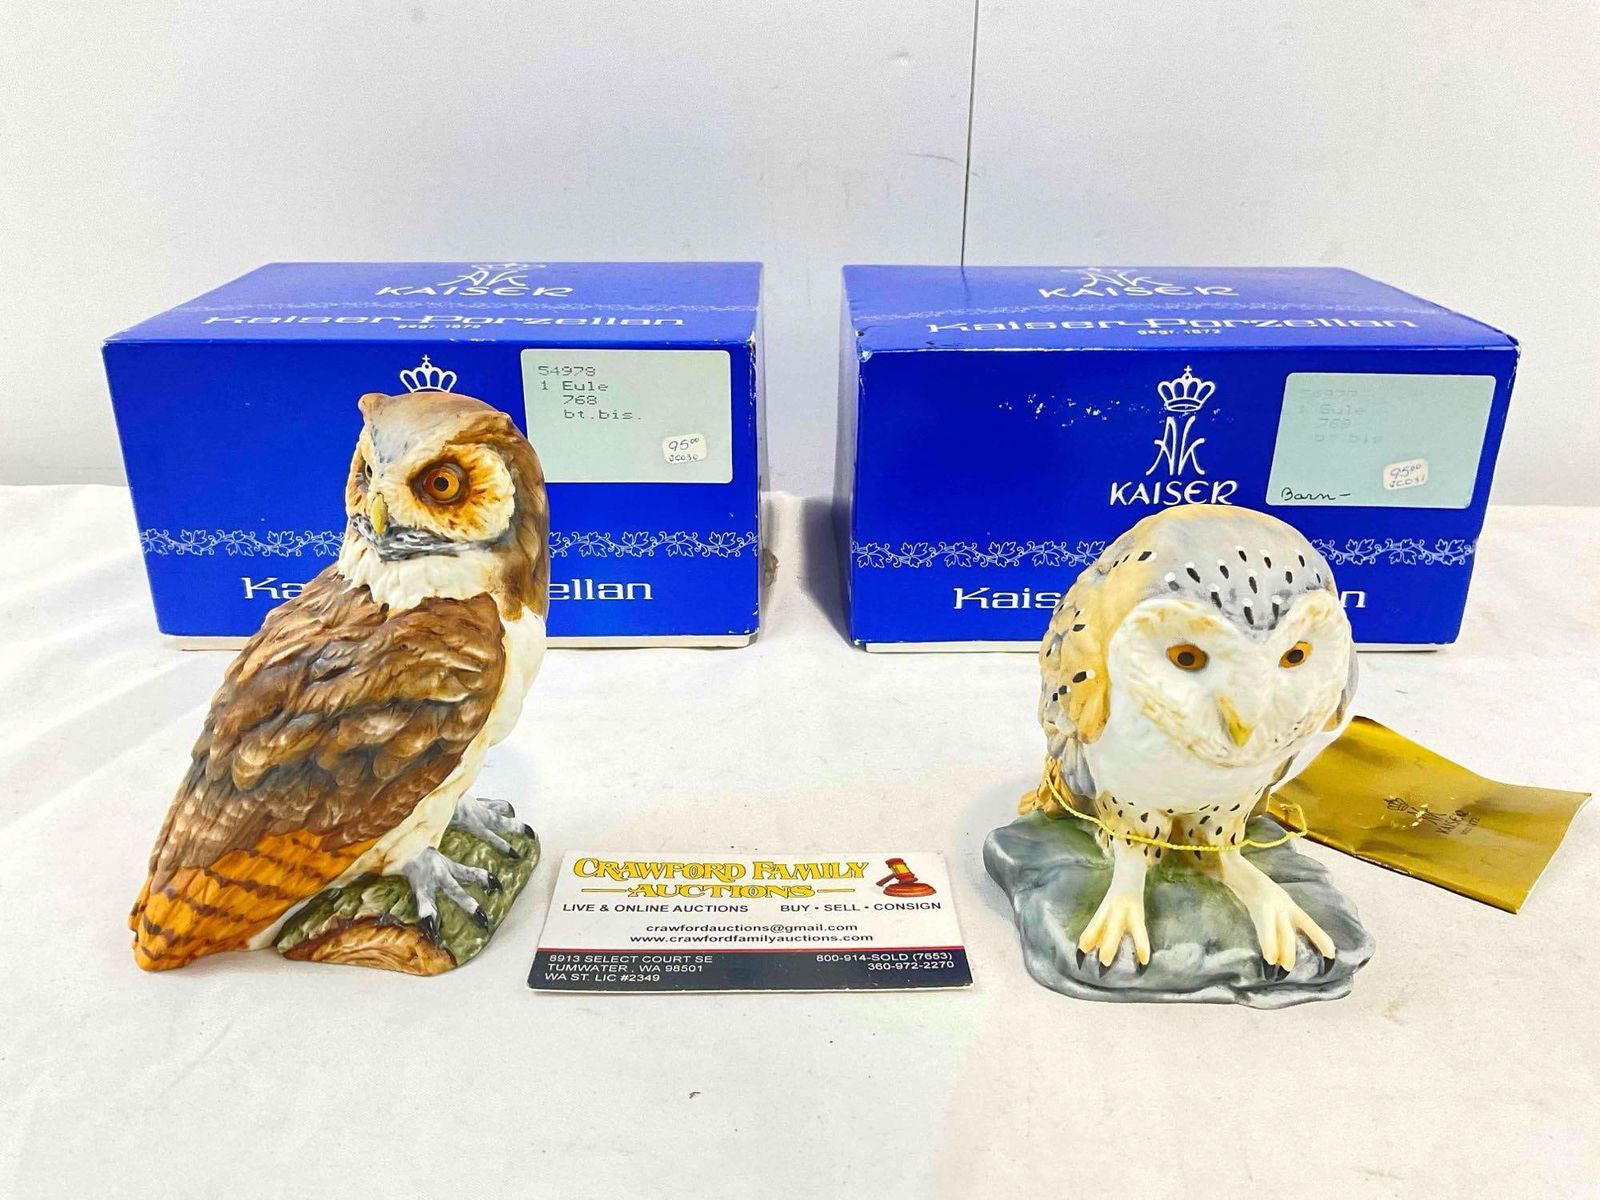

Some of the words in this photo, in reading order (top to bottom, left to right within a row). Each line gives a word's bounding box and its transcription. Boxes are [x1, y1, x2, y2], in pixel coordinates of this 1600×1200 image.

[375, 286, 575, 297] KAISER
[1038, 285, 1240, 298] KAISER
[538, 365, 597, 377] 54978
[562, 381, 609, 392] Eule
[562, 395, 599, 406] 768
[1145, 415, 1206, 476] AK
[1109, 479, 1238, 506] KAISER
[573, 857, 747, 883] CRAWFORD
[752, 861, 870, 881] FAMILY
[627, 884, 816, 899] AUCTIONS
[562, 903, 595, 913] LIVE
[599, 904, 610, 913] &
[614, 904, 669, 913] ONLINE
[672, 904, 750, 914] AUCTIONS
[780, 904, 810, 913] BUY
[823, 904, 861, 912] SELL
[873, 902, 942, 911] CONSIGN
[645, 924, 859, 934] crawfordauctions@gmail.com
[629, 934, 874, 945] www.crawfordfamilyauctions.com
[549, 954, 581, 964] 8913
[584, 955, 639, 964] SELECT
[641, 955, 692, 964] COURT
[694, 955, 714, 964] SE
[815, 953, 909, 963] 800-914-SOLD
[912, 951, 954, 962] (7653)
[547, 963, 630, 974] TUMWATER
[639, 964, 662, 973] WA
[664, 964, 704, 974] 98501
[867, 960, 955, 971] 360-972-2270
[544, 973, 568, 982] WA
[594, 973, 618, 982] LIC
[620, 973, 661, 983] #2349
